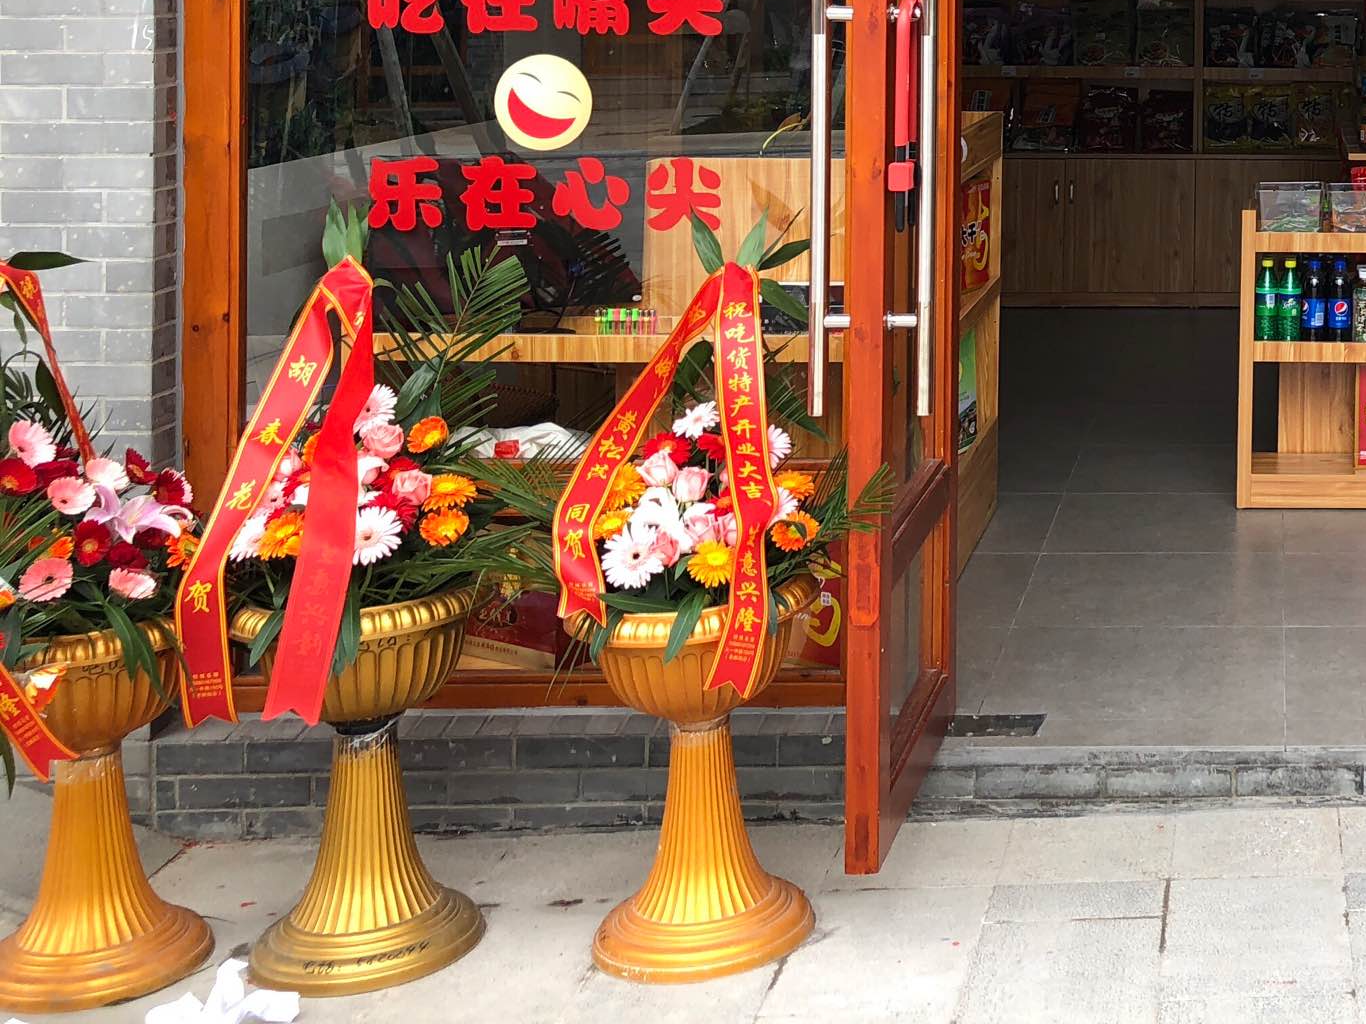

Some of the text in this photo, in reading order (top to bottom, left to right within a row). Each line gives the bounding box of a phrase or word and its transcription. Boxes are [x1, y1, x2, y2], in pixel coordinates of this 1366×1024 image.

[367, 156, 722, 232] 乐在心尖
[723, 302, 765, 499] 祝吃货特产开业大吉
